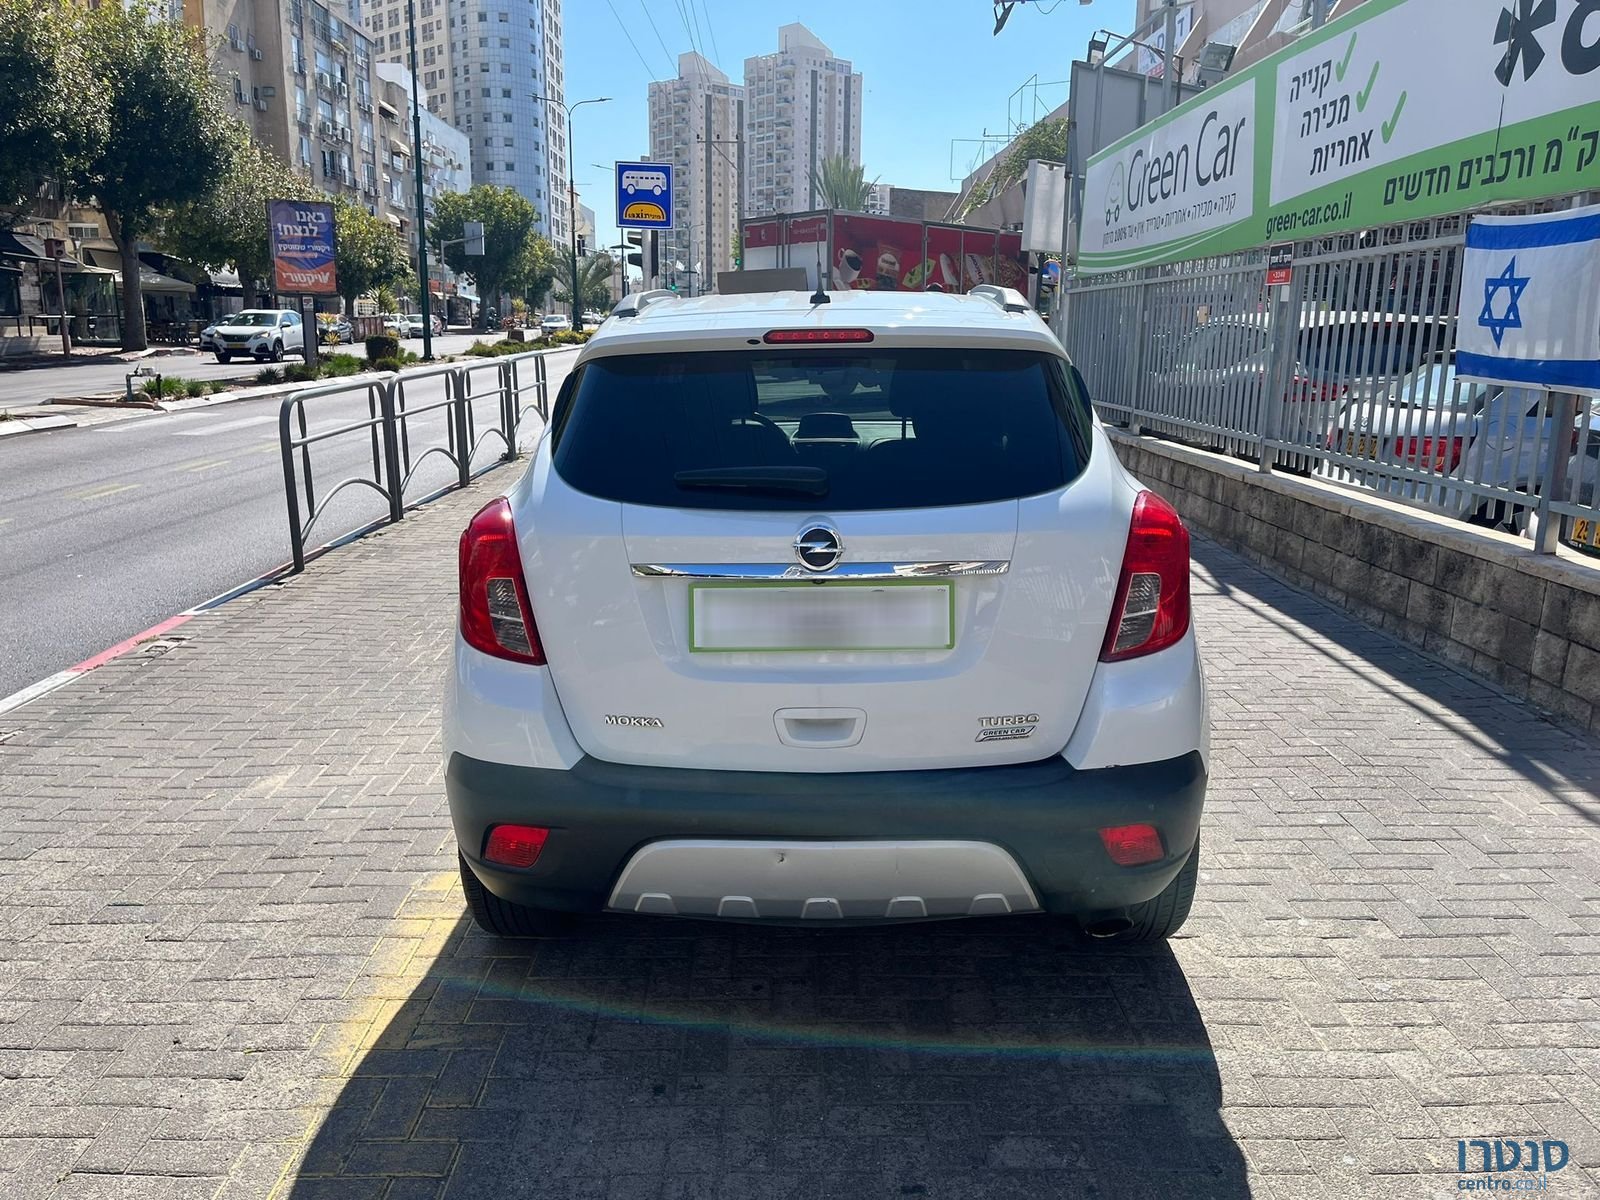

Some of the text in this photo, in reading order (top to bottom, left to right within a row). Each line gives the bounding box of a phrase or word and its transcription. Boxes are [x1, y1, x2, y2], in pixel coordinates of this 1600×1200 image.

[1290, 60, 1332, 103] קנייה
[1301, 94, 1350, 138] מכירה
[1127, 111, 1246, 212] Green Car
[1310, 129, 1374, 176] אחריות
[1456, 144, 1536, 191] ורכבים
[1218, 193, 1237, 216] קניה
[1383, 165, 1451, 206] חדשים
[277, 222, 318, 237] לנצח!
[296, 210, 327, 223] באנו
[1192, 200, 1213, 221] מכירה
[1266, 192, 1353, 240] green-car.co.il
[604, 714, 664, 728] MOKKA
[978, 713, 1040, 727] TURBO
